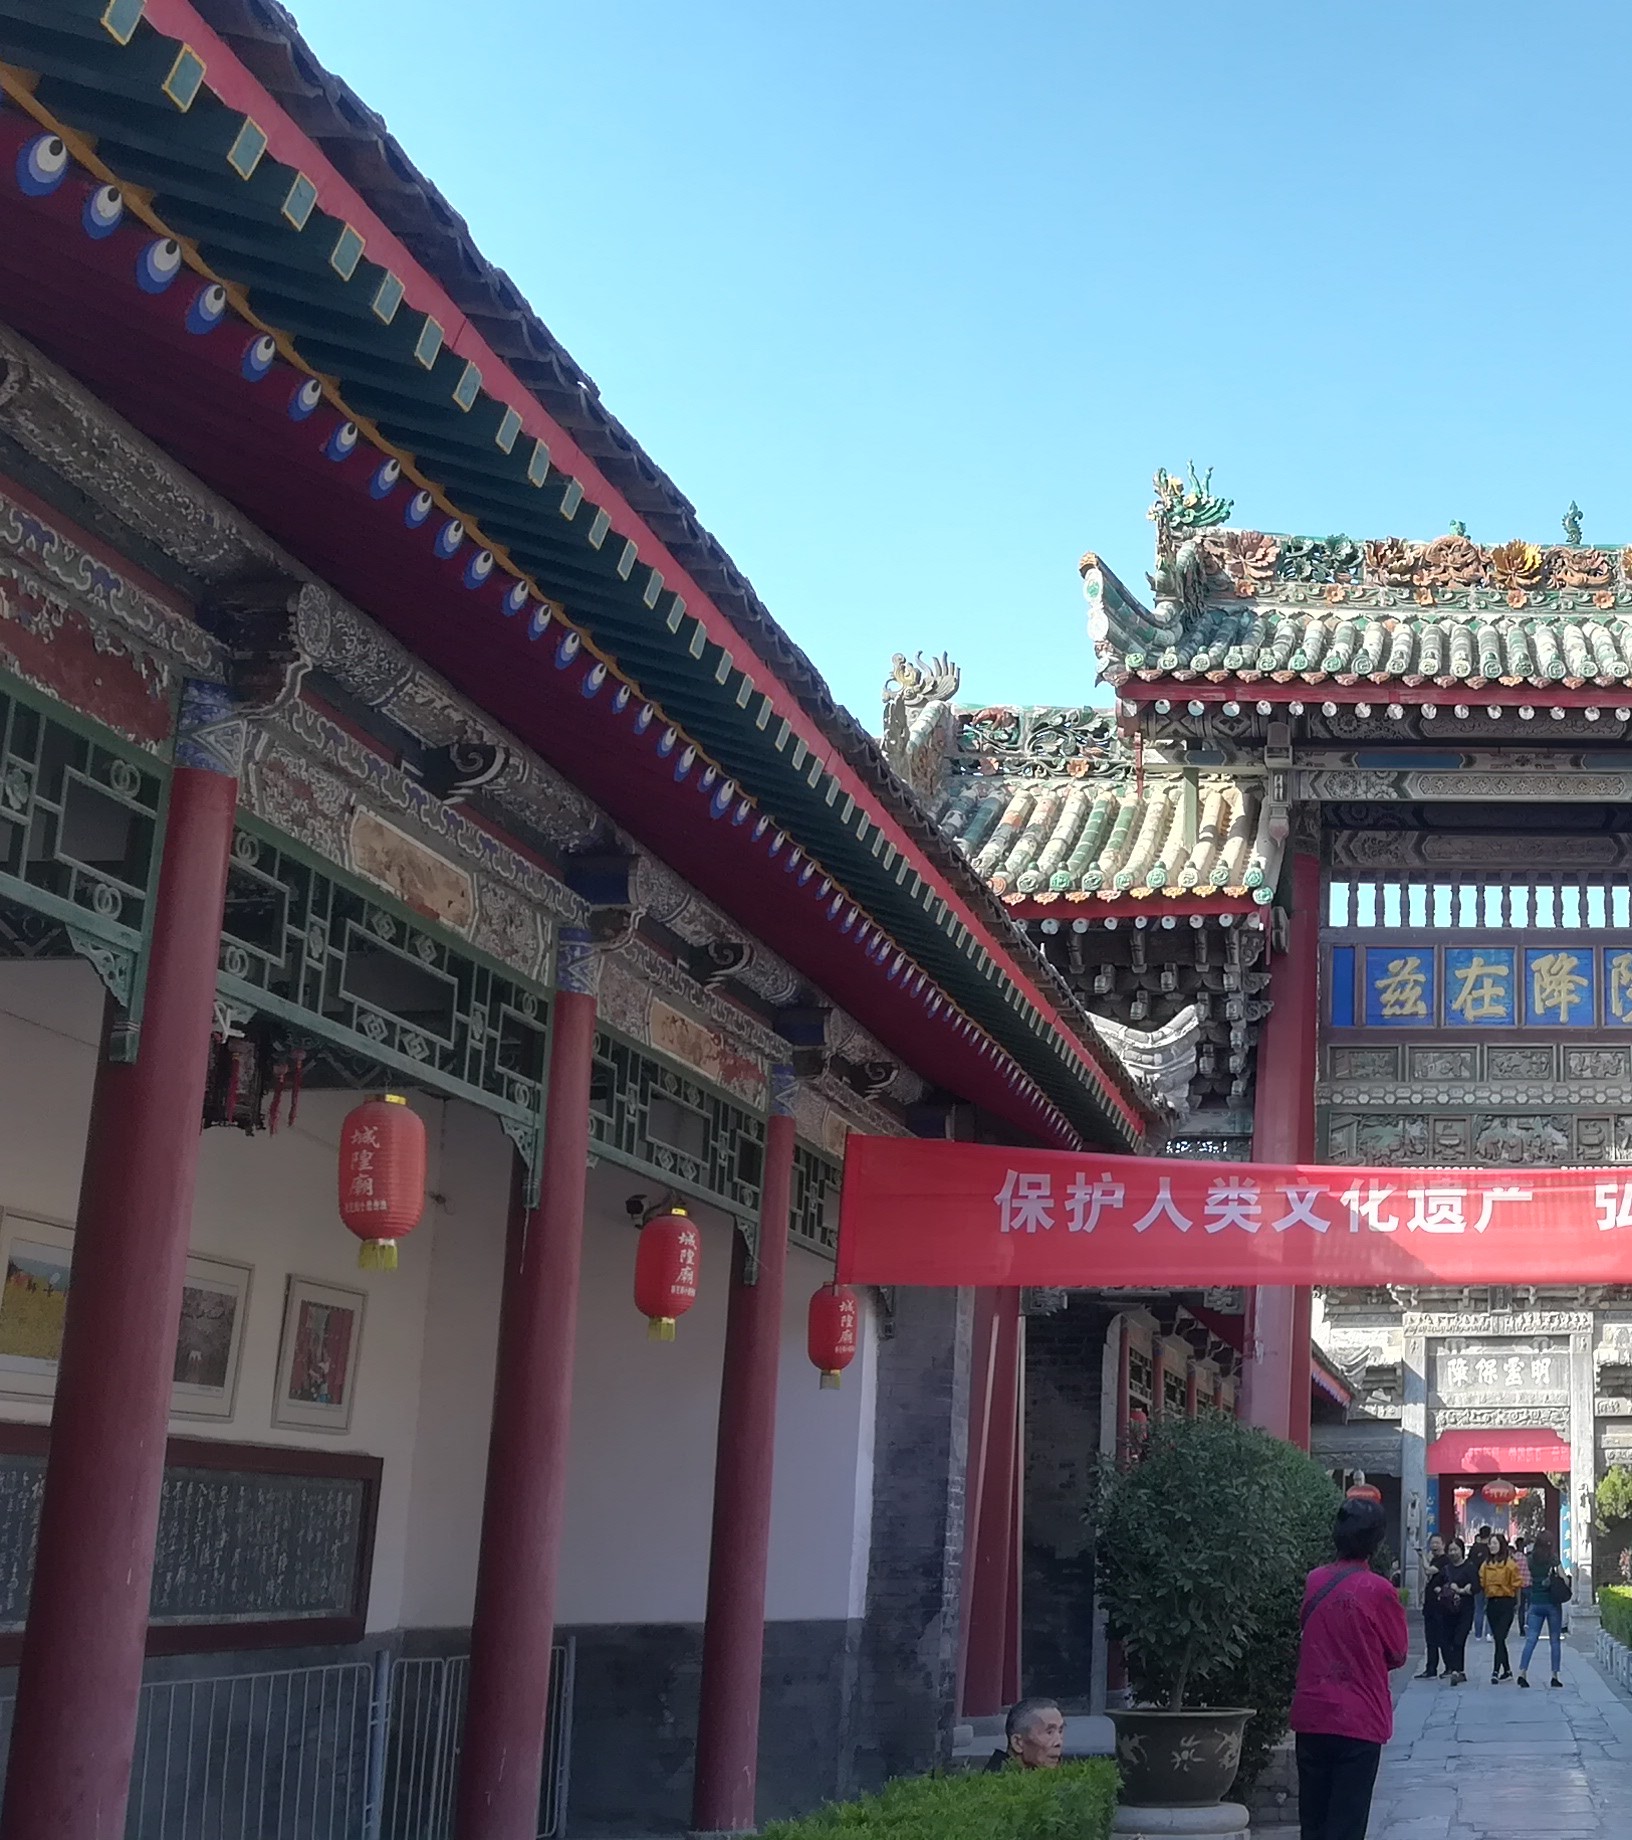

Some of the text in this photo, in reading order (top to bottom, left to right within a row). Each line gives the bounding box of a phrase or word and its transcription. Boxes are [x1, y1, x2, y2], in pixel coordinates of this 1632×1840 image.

[994, 1168, 1534, 1234] 保护人类文化遗产
